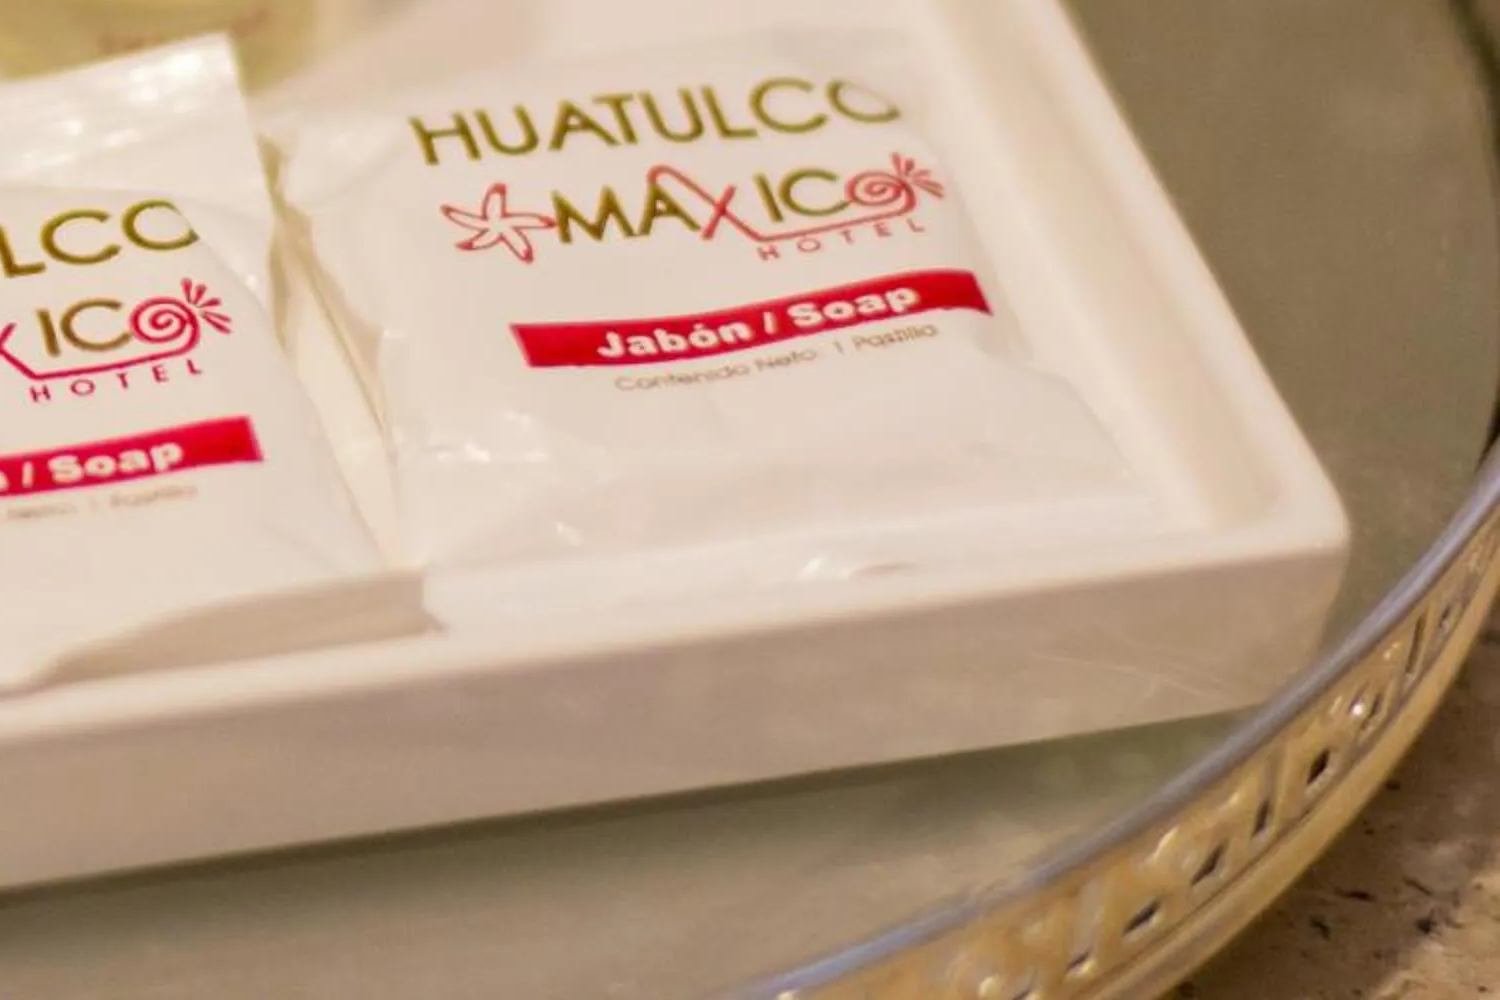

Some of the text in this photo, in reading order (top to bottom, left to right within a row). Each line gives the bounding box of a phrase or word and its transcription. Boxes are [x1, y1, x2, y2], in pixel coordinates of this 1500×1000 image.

[756, 217, 926, 261] HOTEL
[597, 320, 754, 358] Jabón
[786, 287, 922, 329] Soap
[30, 357, 204, 403] HOTEL
[46, 441, 184, 485] Soap
